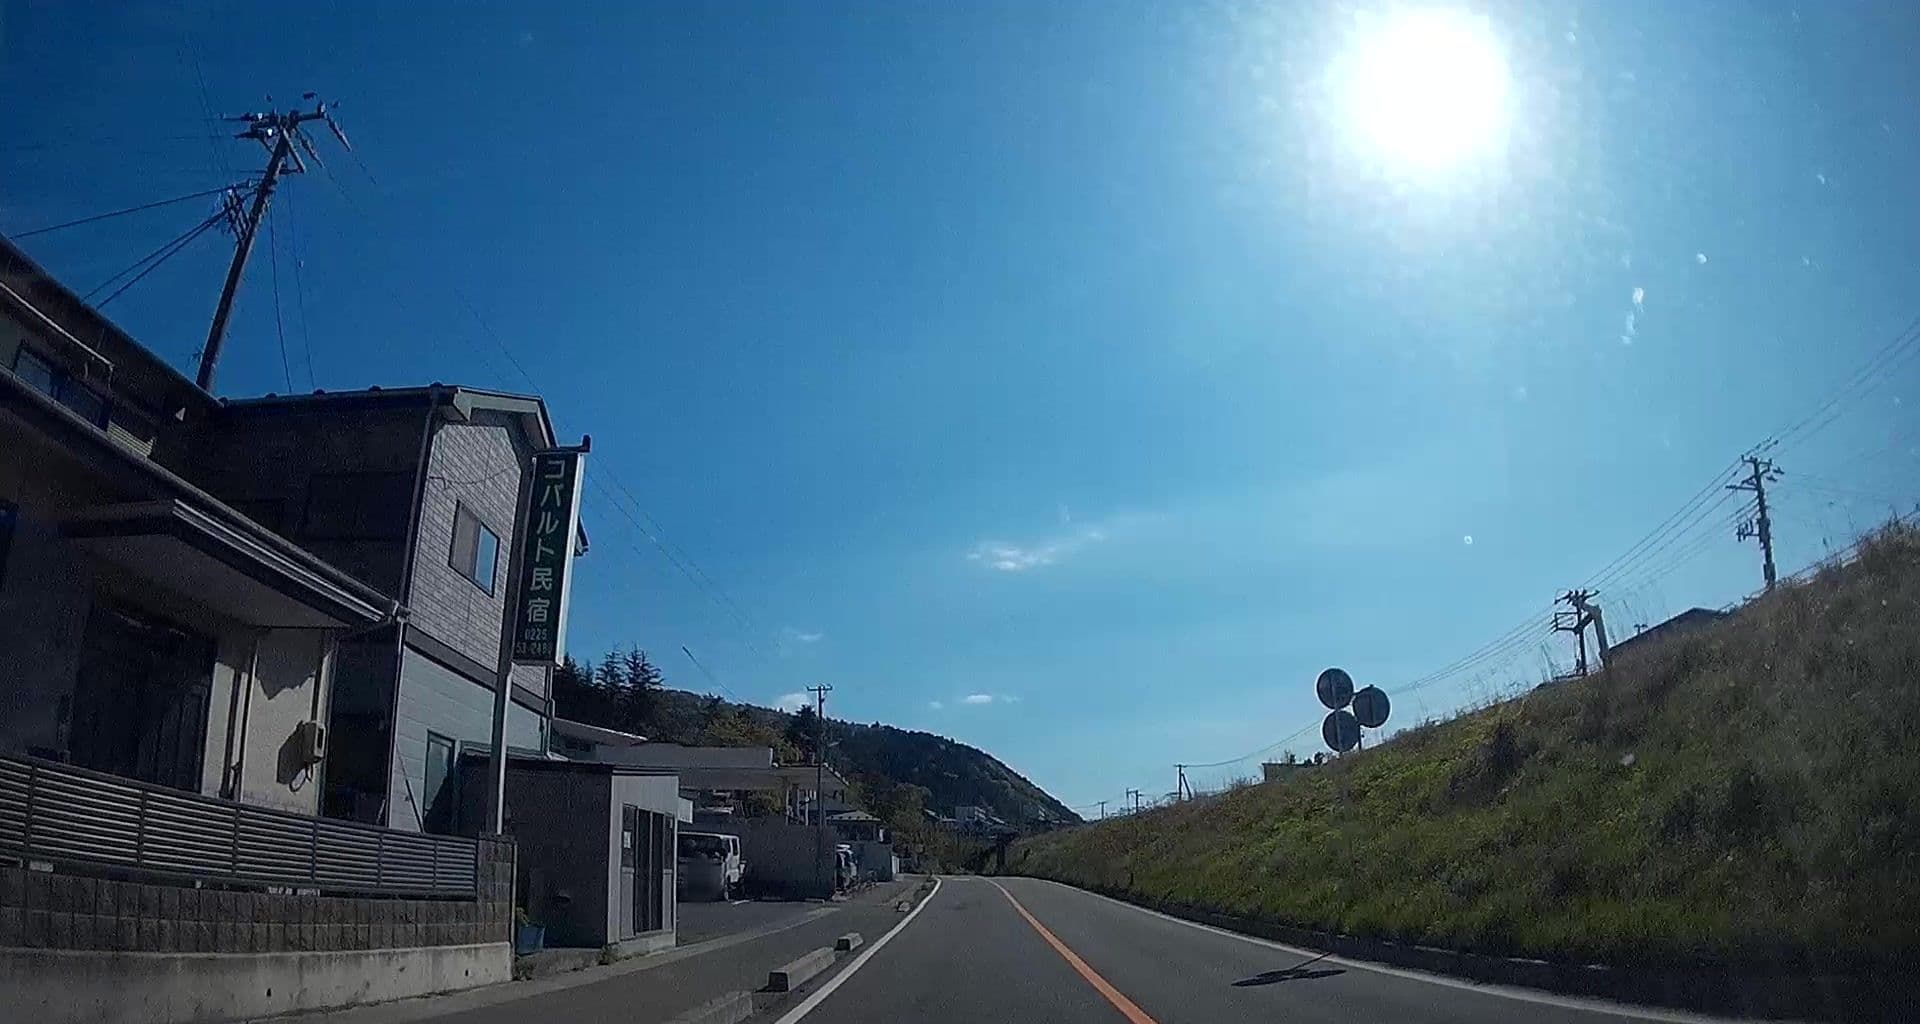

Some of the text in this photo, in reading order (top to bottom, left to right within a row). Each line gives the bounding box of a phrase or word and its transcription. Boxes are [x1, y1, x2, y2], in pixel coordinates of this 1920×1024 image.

[527, 459, 566, 623] コバルト民宿
[524, 628, 548, 641] 0225
